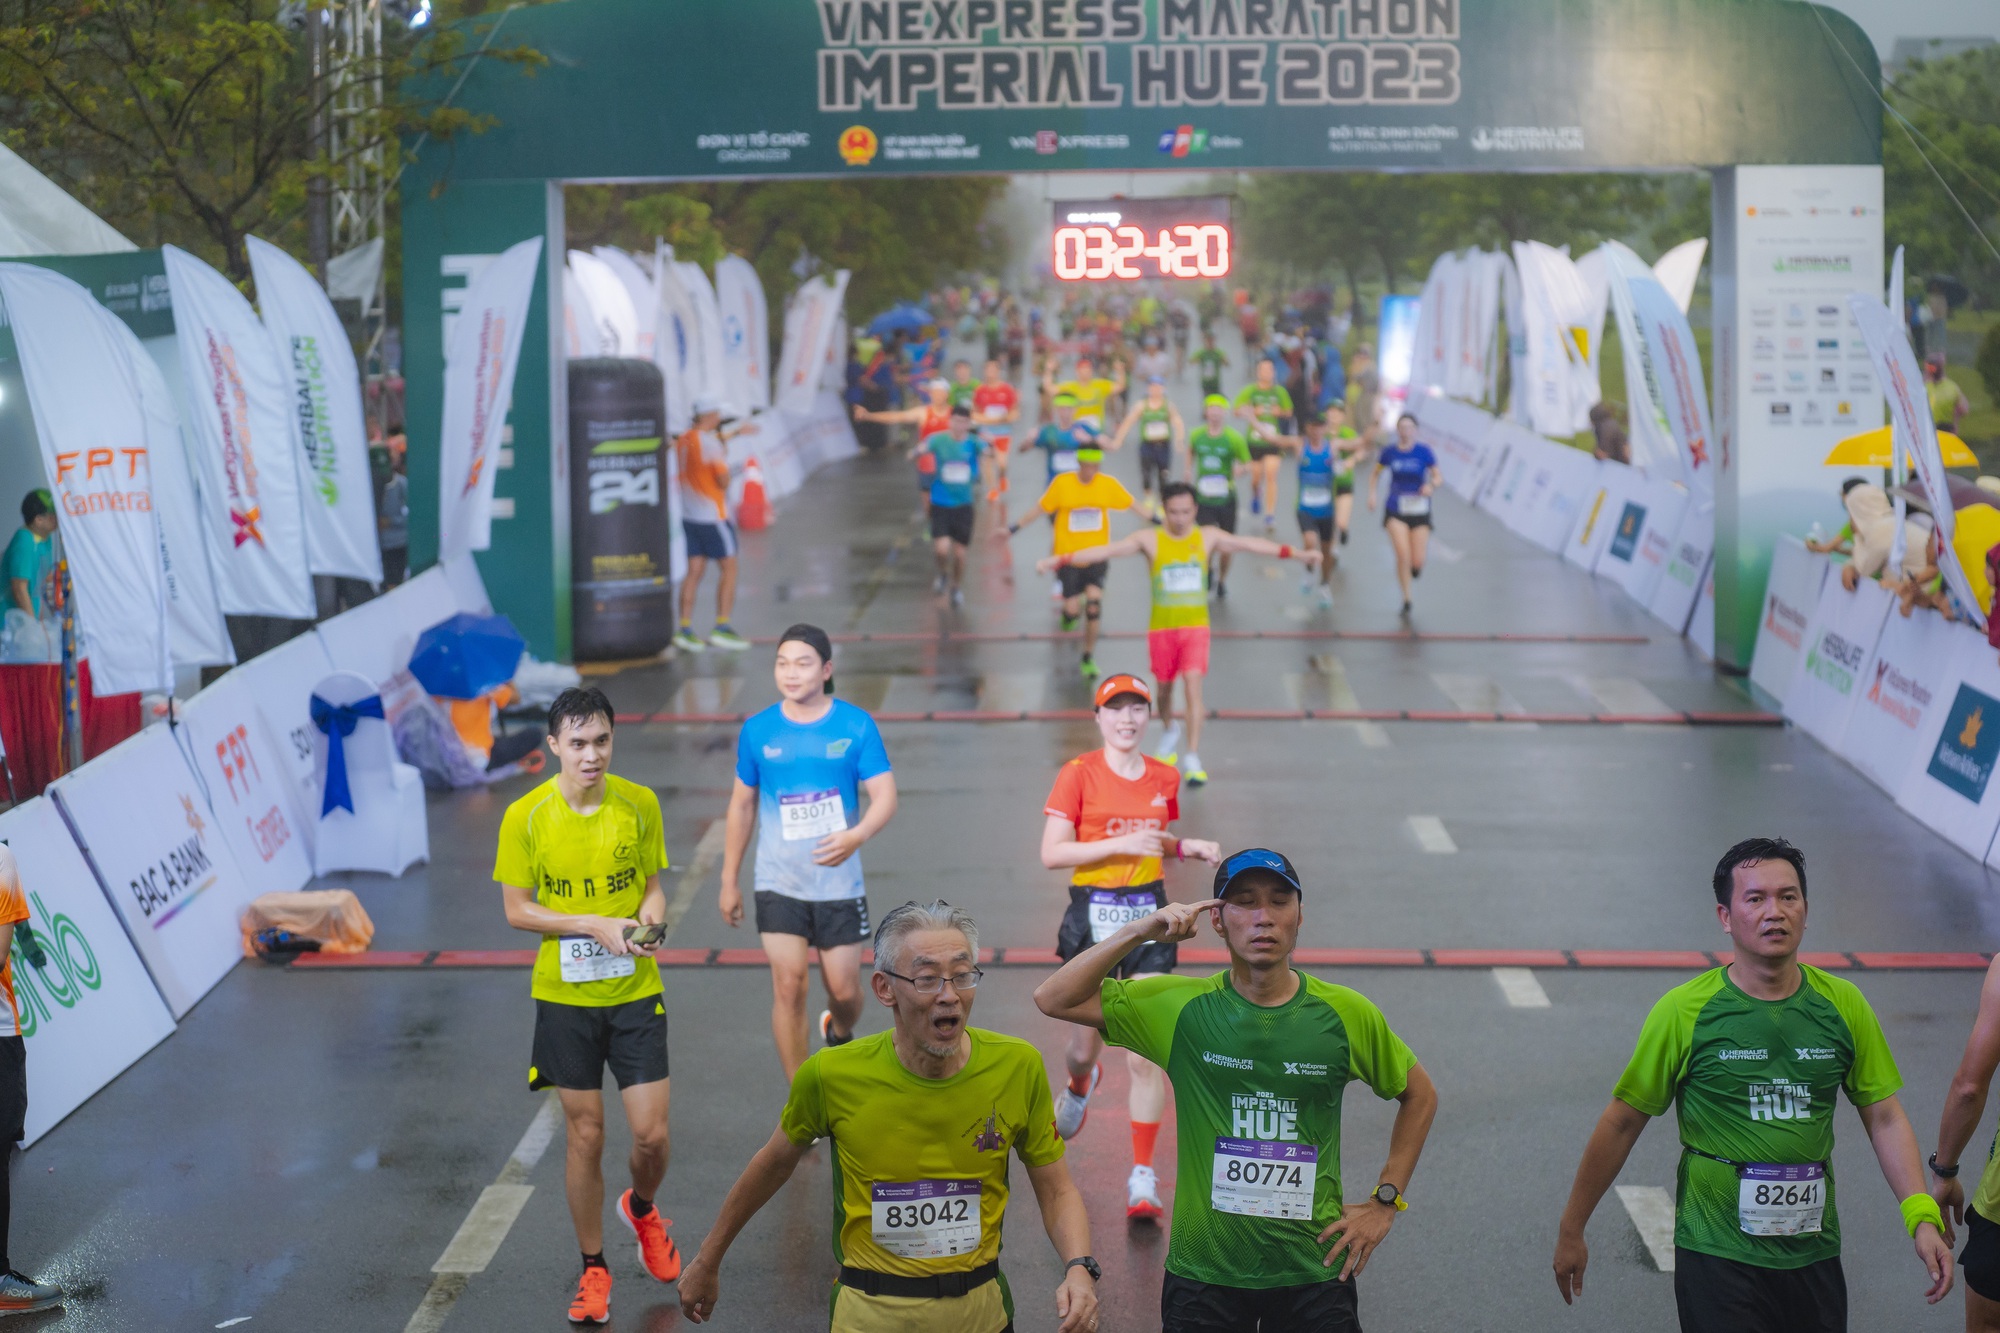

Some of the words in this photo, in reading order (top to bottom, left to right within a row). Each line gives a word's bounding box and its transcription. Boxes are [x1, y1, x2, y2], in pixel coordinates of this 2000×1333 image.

[818, 0, 1143, 45] VNEXPRESS
[1158, 0, 1461, 41] MARATHON
[817, 46, 1123, 111] IMPERIAL
[1131, 44, 1268, 107] HUE
[1276, 43, 1461, 106] 2023
[56, 446, 148, 486] FPT
[62, 490, 152, 517] Camera
[216, 723, 262, 805] FPT
[790, 801, 835, 821] 83071
[130, 865, 168, 918] BAC
[160, 858, 182, 897] A
[1212, 1053, 1254, 1066] HERBALIFE
[1212, 1059, 1254, 1071] NUTRITION
[1299, 1062, 1328, 1070] VnExpress
[1231, 1095, 1298, 1112] IMPERIAL
[1749, 1084, 1811, 1097] IMPERIAL
[1750, 1095, 1812, 1120] HUE
[1232, 1108, 1299, 1140] HUE
[1226, 1160, 1302, 1188] 80774
[1755, 1184, 1818, 1206] 82641
[886, 1199, 969, 1228] 83042
[2, 1286, 33, 1299] HOKA
